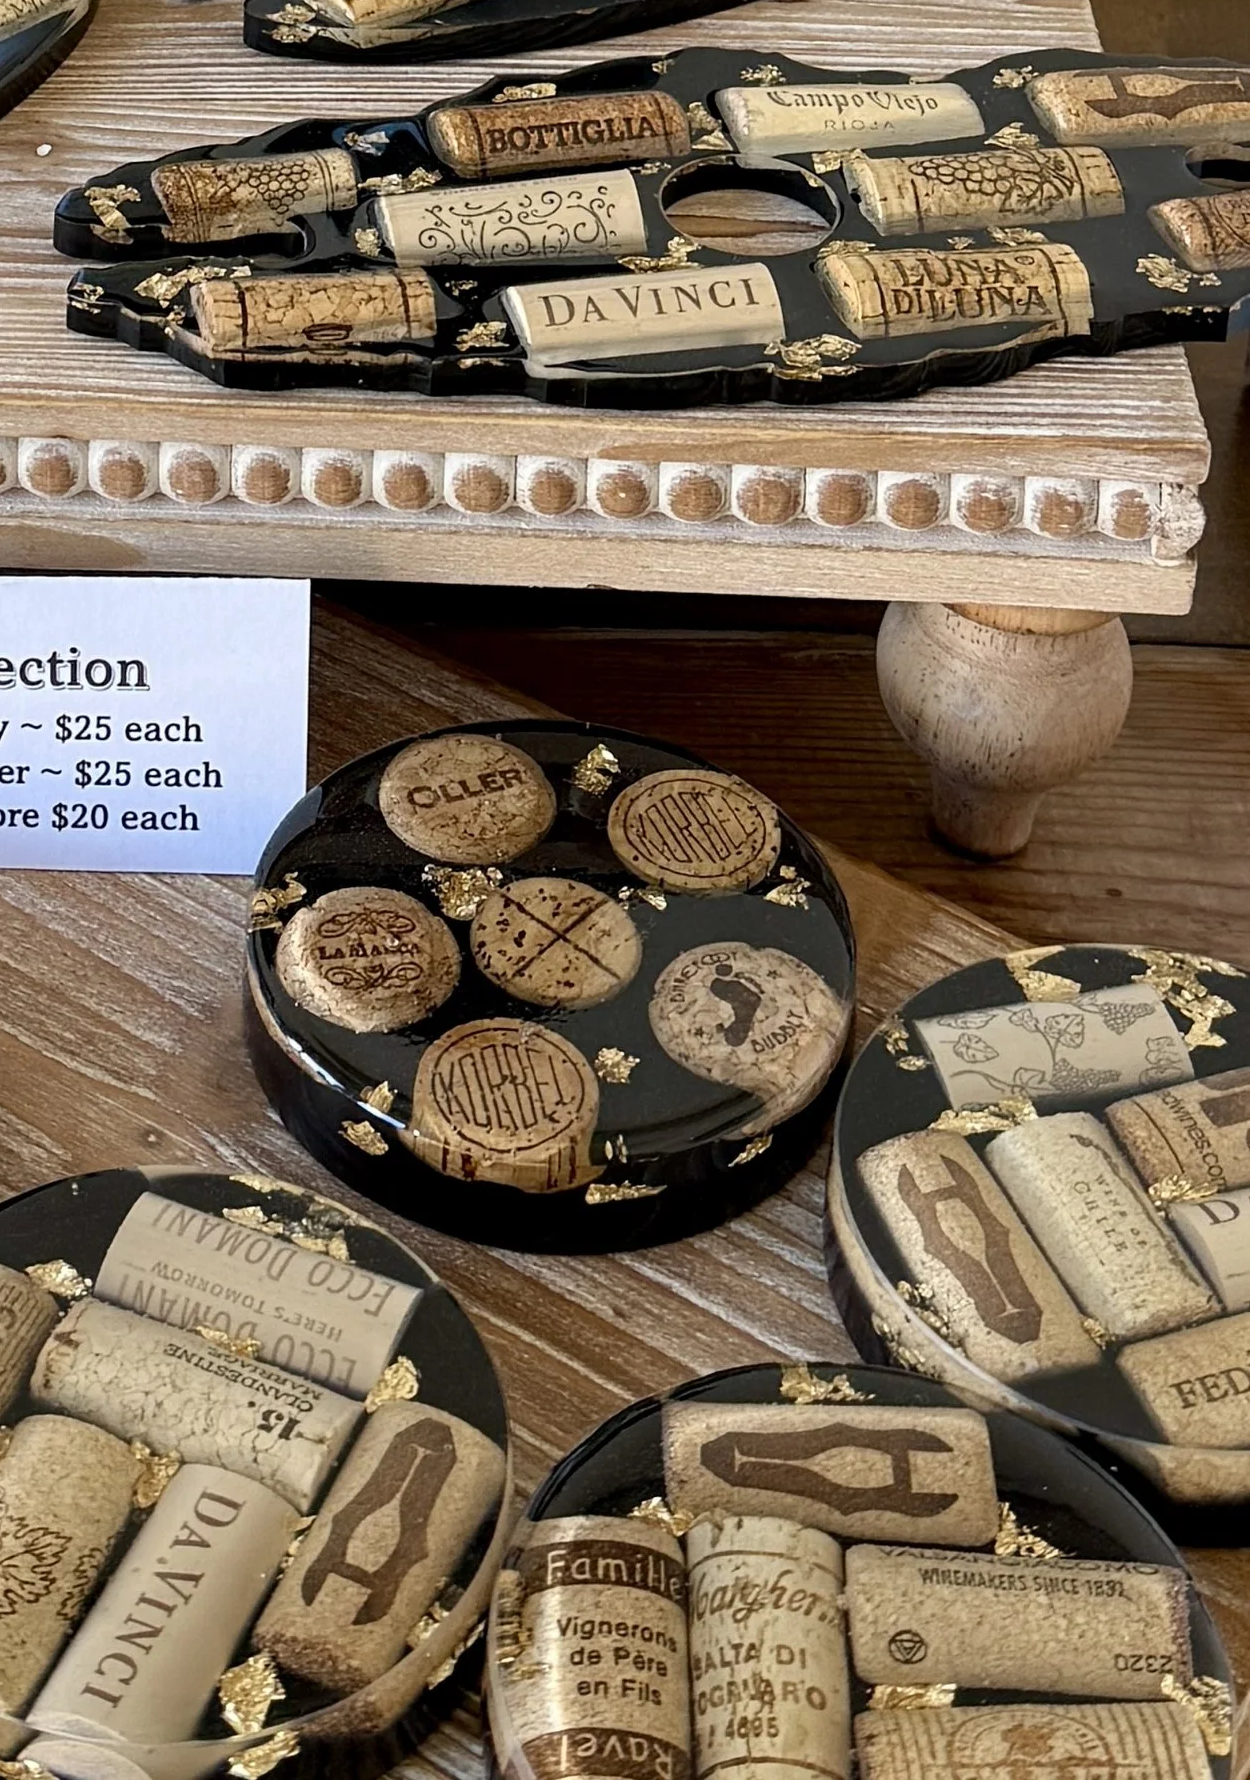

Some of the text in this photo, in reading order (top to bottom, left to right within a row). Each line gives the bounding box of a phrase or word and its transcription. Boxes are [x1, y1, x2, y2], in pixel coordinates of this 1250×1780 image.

[767, 91, 938, 116] Campo Viejo
[486, 116, 659, 153] BOTTIGLIA
[825, 120, 895, 131] RIOJA
[538, 278, 760, 327] DA VINCI
[55, 714, 112, 743] $25
[125, 716, 203, 743] each
[75, 760, 132, 788] $25
[144, 762, 222, 789] each
[407, 769, 527, 808] OLLER
[51, 802, 108, 832] $20
[121, 804, 200, 832] each
[636, 792, 758, 863] KORBEL
[751, 1010, 803, 1053] BUBBLY
[439, 1044, 575, 1131] KORBEL
[1074, 1181, 1128, 1252] CHILE
[153, 1203, 396, 1317] ECCO DOMANI
[151, 1261, 343, 1343] HERE'S TOMORROW
[163, 1343, 313, 1413] CLANDESTINE
[207, 1346, 323, 1400] MARRIAGE
[272, 1334, 357, 1387] ECCO
[546, 1549, 686, 1600] Famille
[919, 1568, 1026, 1591] WINEMAKERS
[1033, 1577, 1079, 1595] SINCE
[80, 1486, 248, 1709] DA VINCI
[557, 1617, 678, 1653] Vignerons
[570, 1646, 668, 1678] de Père
[775, 1644, 806, 1668] DI
[577, 1678, 662, 1706] en Fils
